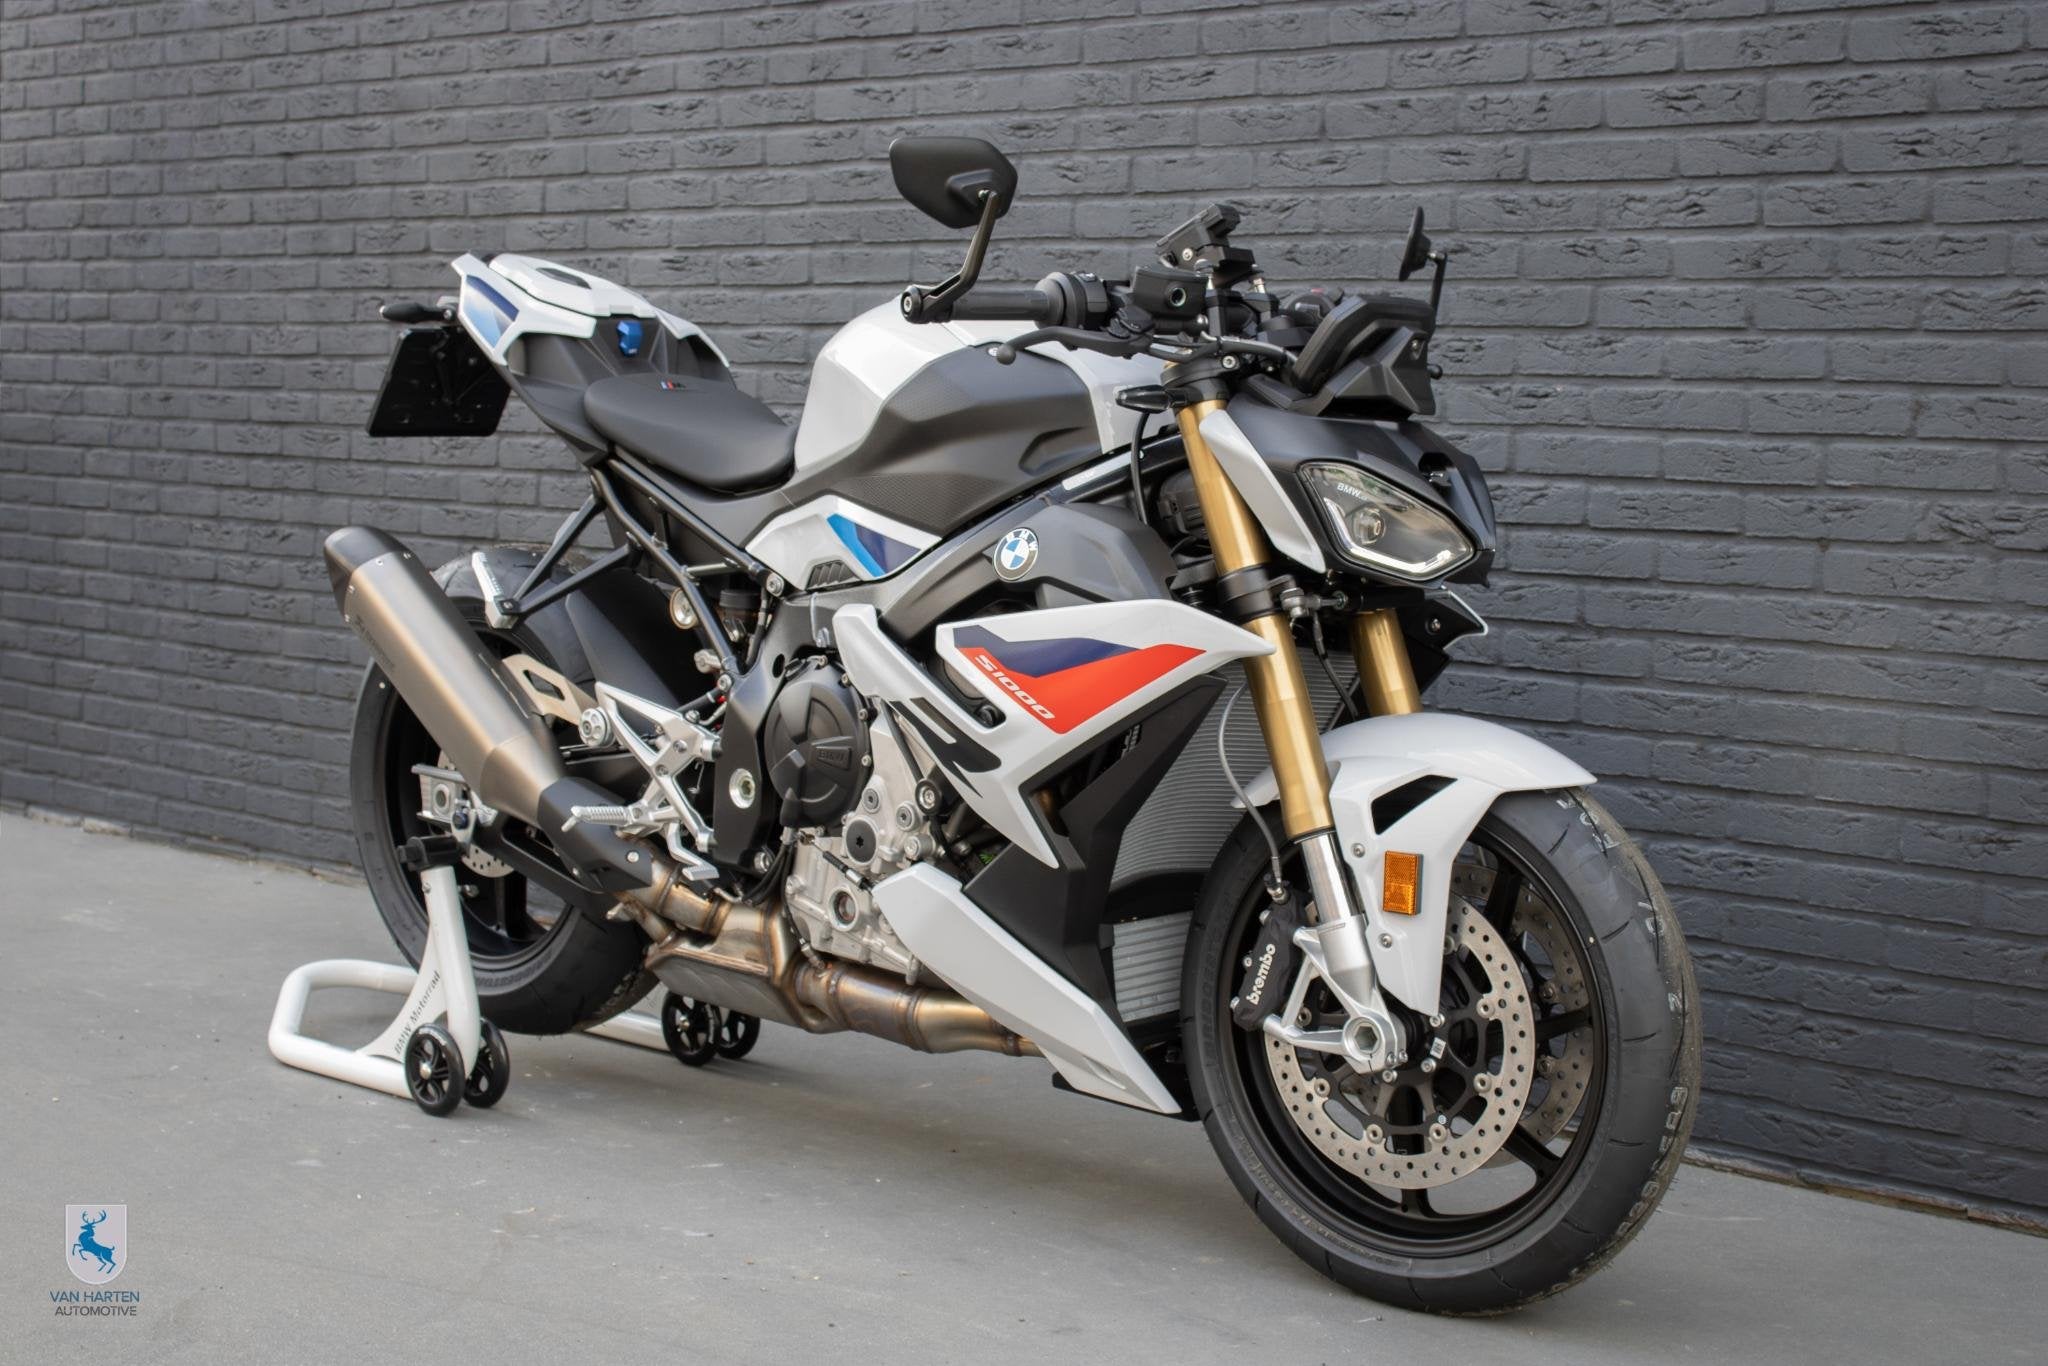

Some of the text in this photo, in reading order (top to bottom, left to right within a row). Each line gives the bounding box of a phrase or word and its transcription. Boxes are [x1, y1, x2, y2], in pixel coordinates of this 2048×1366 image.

[1337, 482, 1361, 498] BMW
[974, 654, 1056, 719] S1000
[410, 970, 441, 1024] Motorrad
[1246, 943, 1276, 1005] brembo
